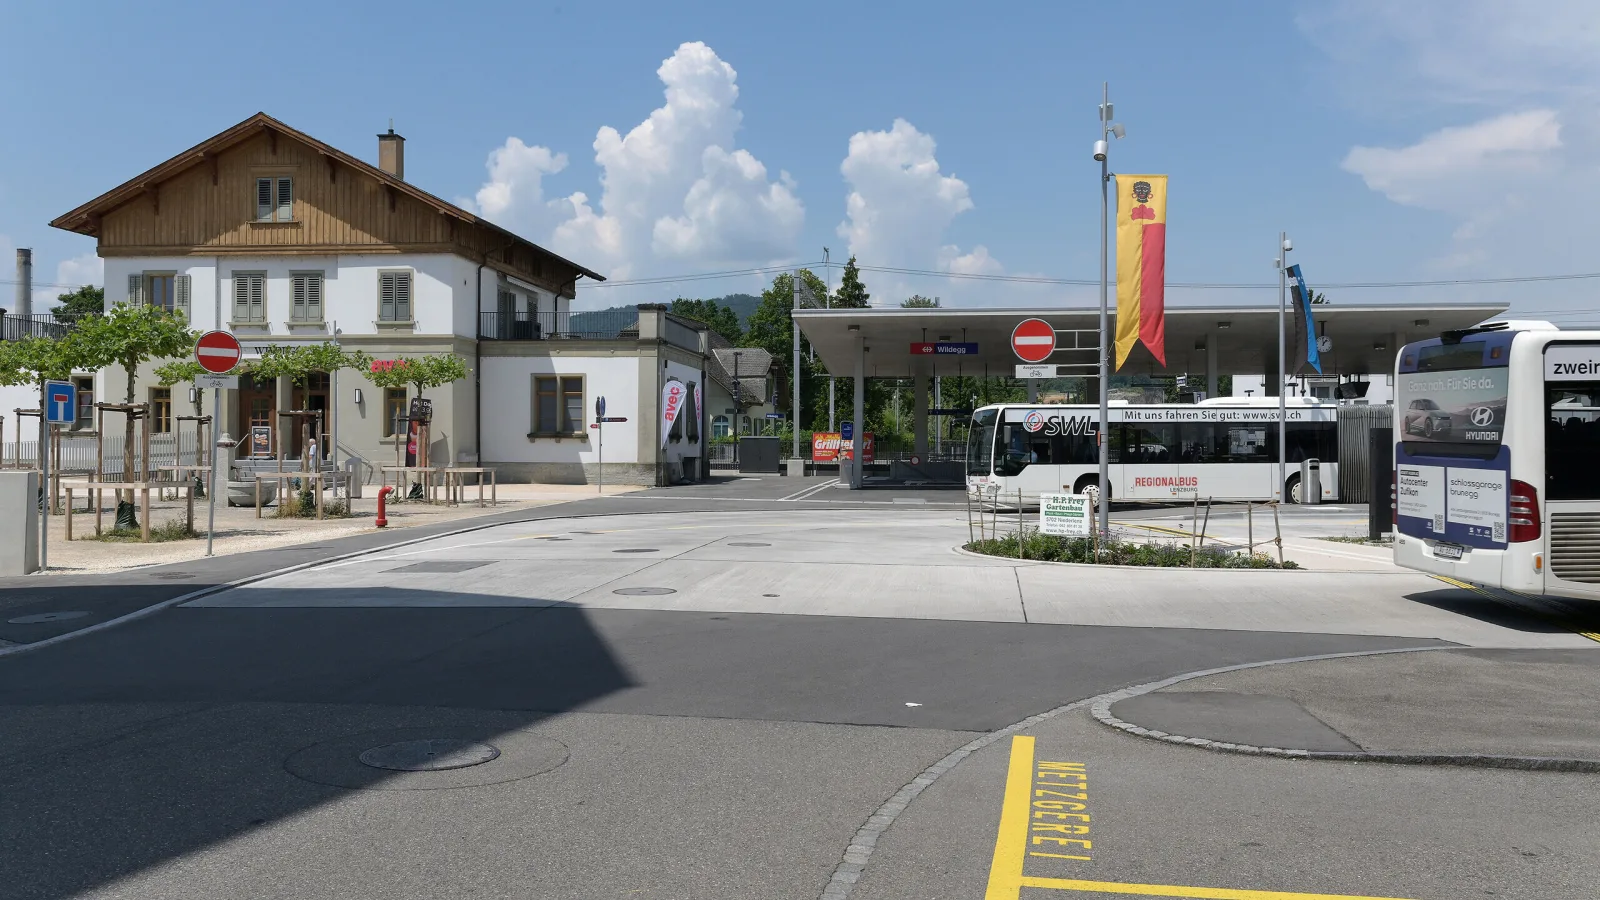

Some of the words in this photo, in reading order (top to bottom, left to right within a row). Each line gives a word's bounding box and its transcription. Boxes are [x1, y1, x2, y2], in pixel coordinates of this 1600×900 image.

[937, 346, 966, 354] Wildegg
[1408, 381, 1427, 391] Ganz
[1428, 380, 1445, 391] nah.
[1447, 378, 1460, 390] Für
[1462, 377, 1477, 389] Sie
[1478, 376, 1494, 389] da.
[665, 387, 680, 421] avec
[1124, 411, 1141, 420] Mit
[1145, 412, 1162, 420] uns
[1166, 411, 1198, 420] fahren
[1201, 411, 1217, 420] Sie
[1220, 411, 1240, 421] gut:
[1045, 415, 1097, 436] SWL
[1466, 431, 1498, 440] HYUNDAI
[1135, 477, 1198, 486] REGIONALBUS
[1400, 477, 1428, 487] Autocenter
[1450, 479, 1502, 491] schlossgarage
[1450, 488, 1478, 499] brunegg
[1053, 496, 1067, 504] H.P.
[1068, 497, 1085, 505] Frey
[1029, 760, 1092, 860] METZGEREI
